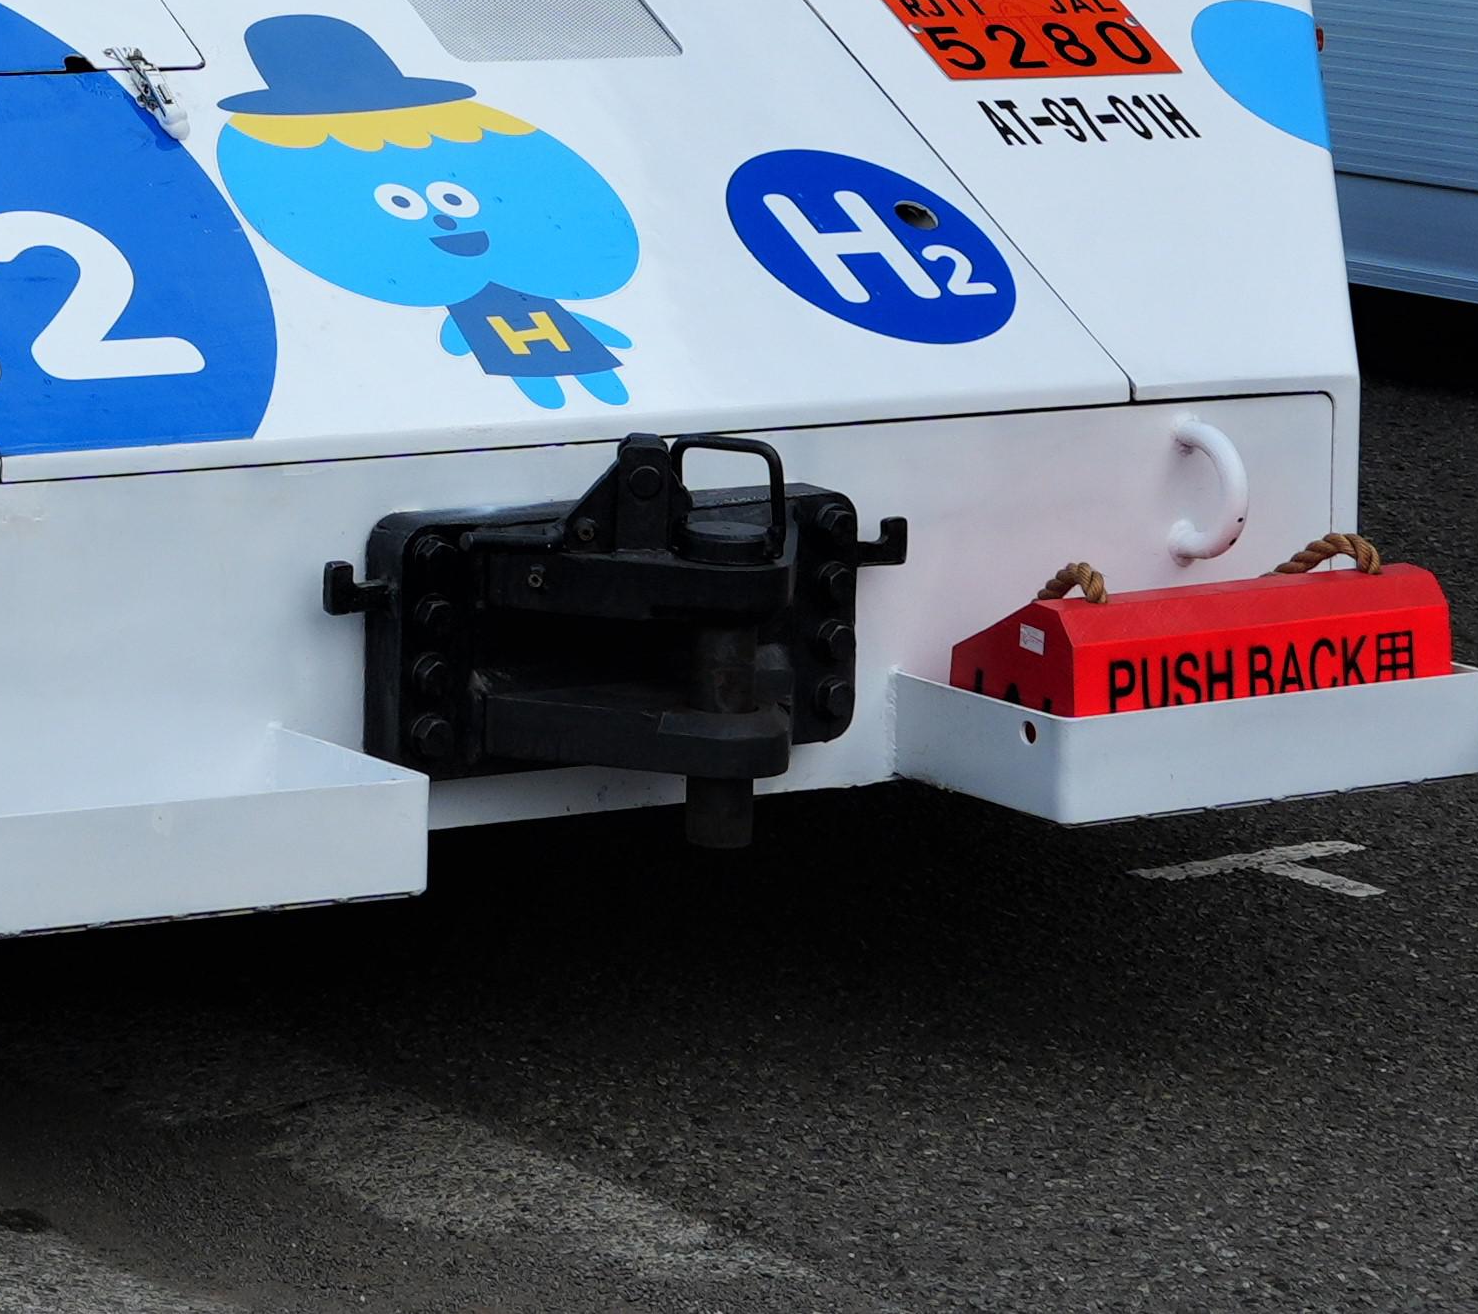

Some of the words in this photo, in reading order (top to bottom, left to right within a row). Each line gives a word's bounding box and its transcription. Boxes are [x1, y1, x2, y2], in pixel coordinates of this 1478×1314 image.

[923, 21, 1152, 71] 5280
[977, 94, 1202, 146] AT-97-01H
[762, 189, 996, 303] H2
[493, 309, 572, 356] H
[1109, 646, 1234, 713] PUSH
